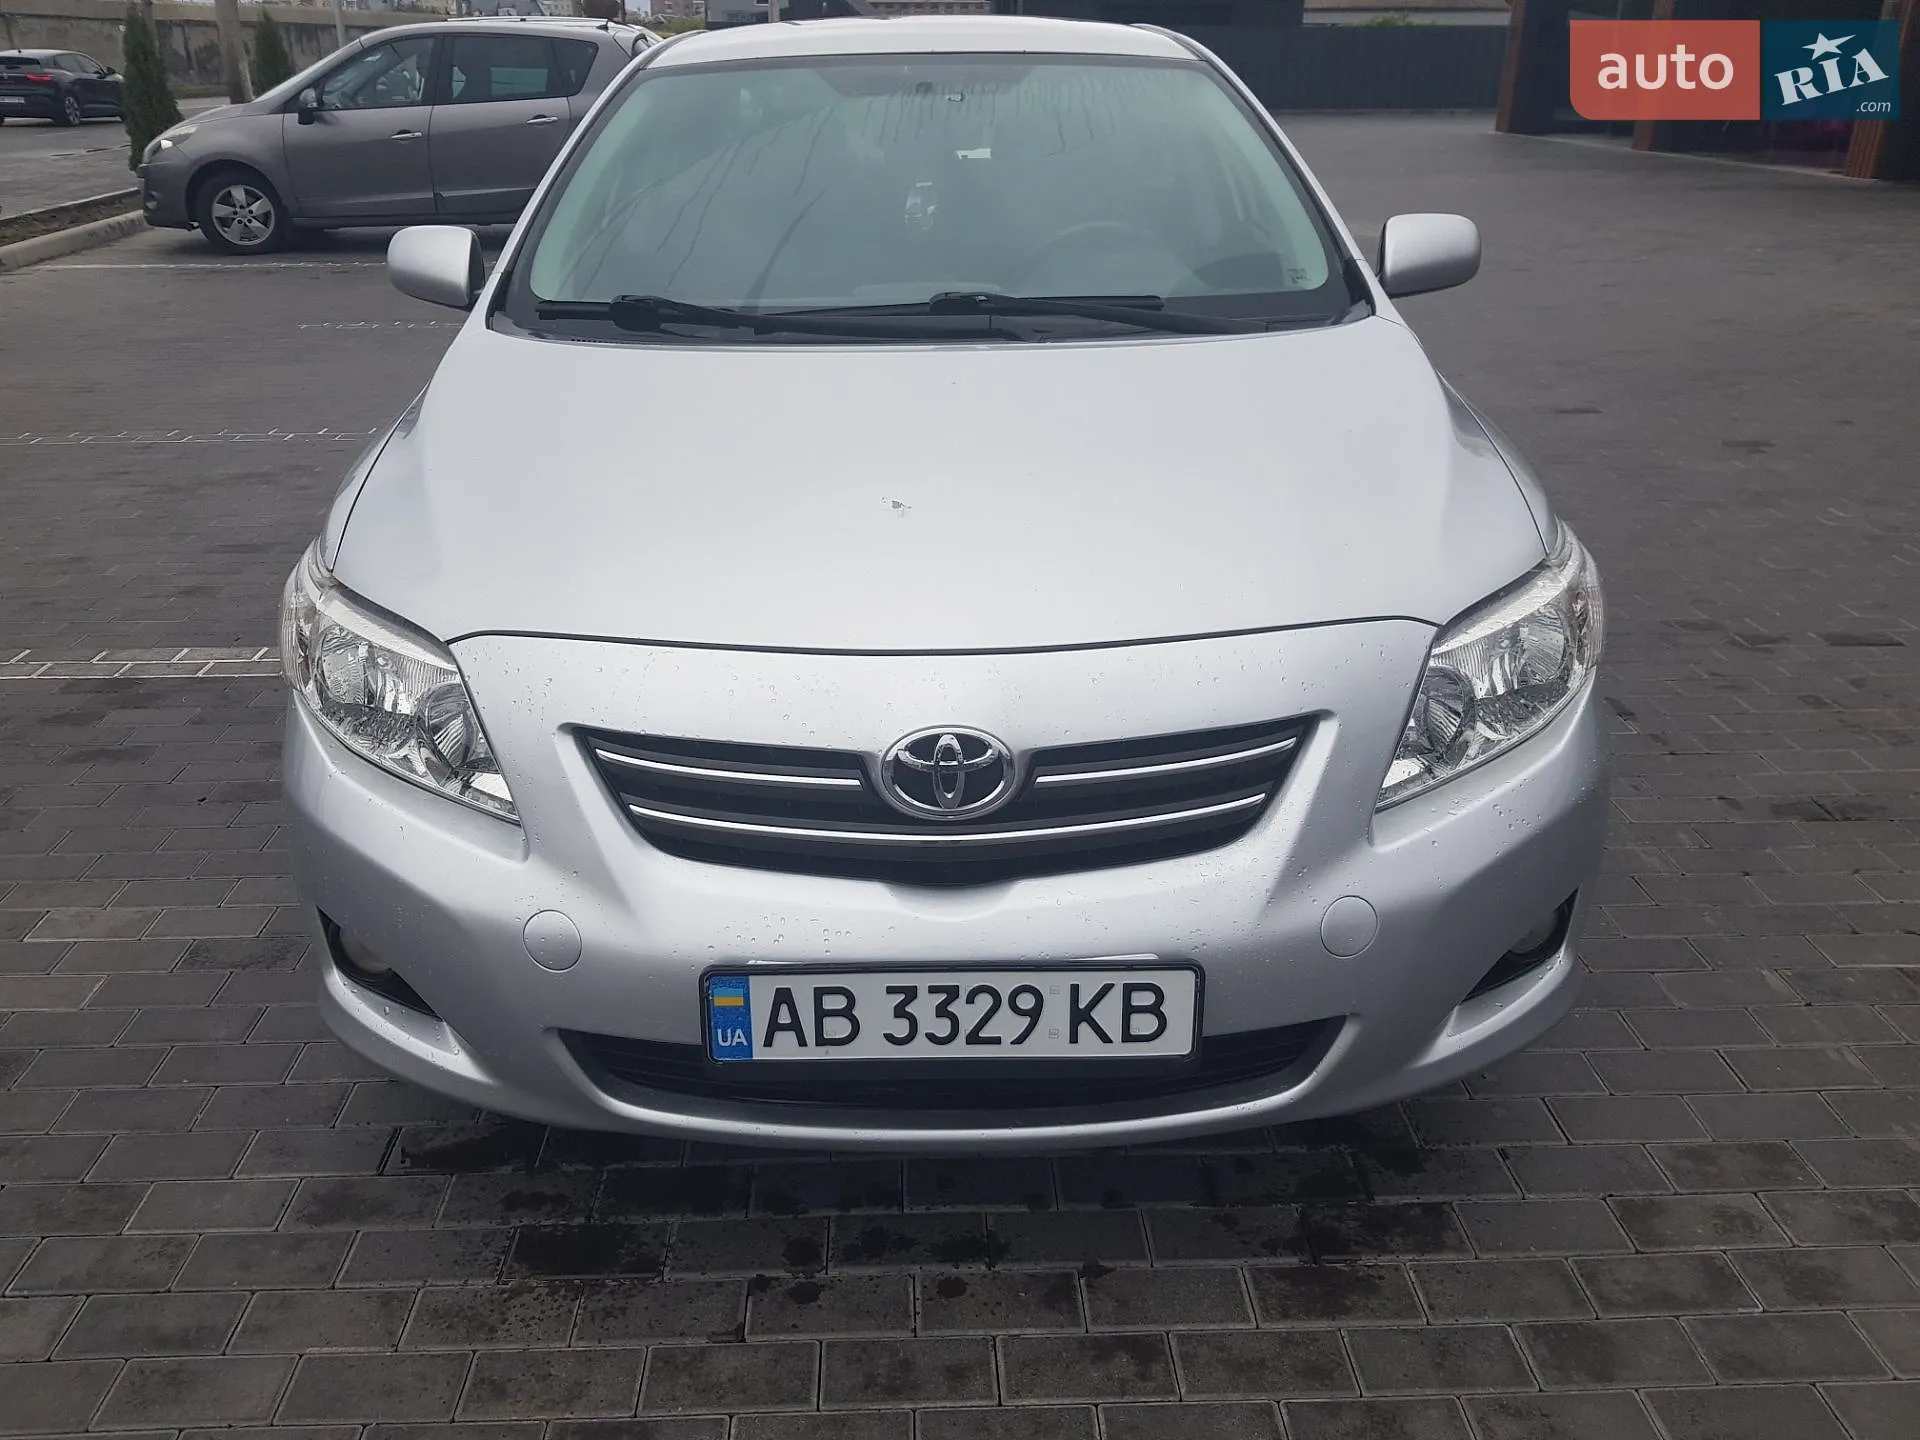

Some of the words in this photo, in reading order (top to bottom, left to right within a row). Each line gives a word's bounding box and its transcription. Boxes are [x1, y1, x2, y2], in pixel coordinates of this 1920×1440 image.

[763, 986, 860, 1047] AB
[883, 983, 1045, 1045] 3329
[1070, 982, 1167, 1043] KB
[717, 1030, 749, 1048] UA
